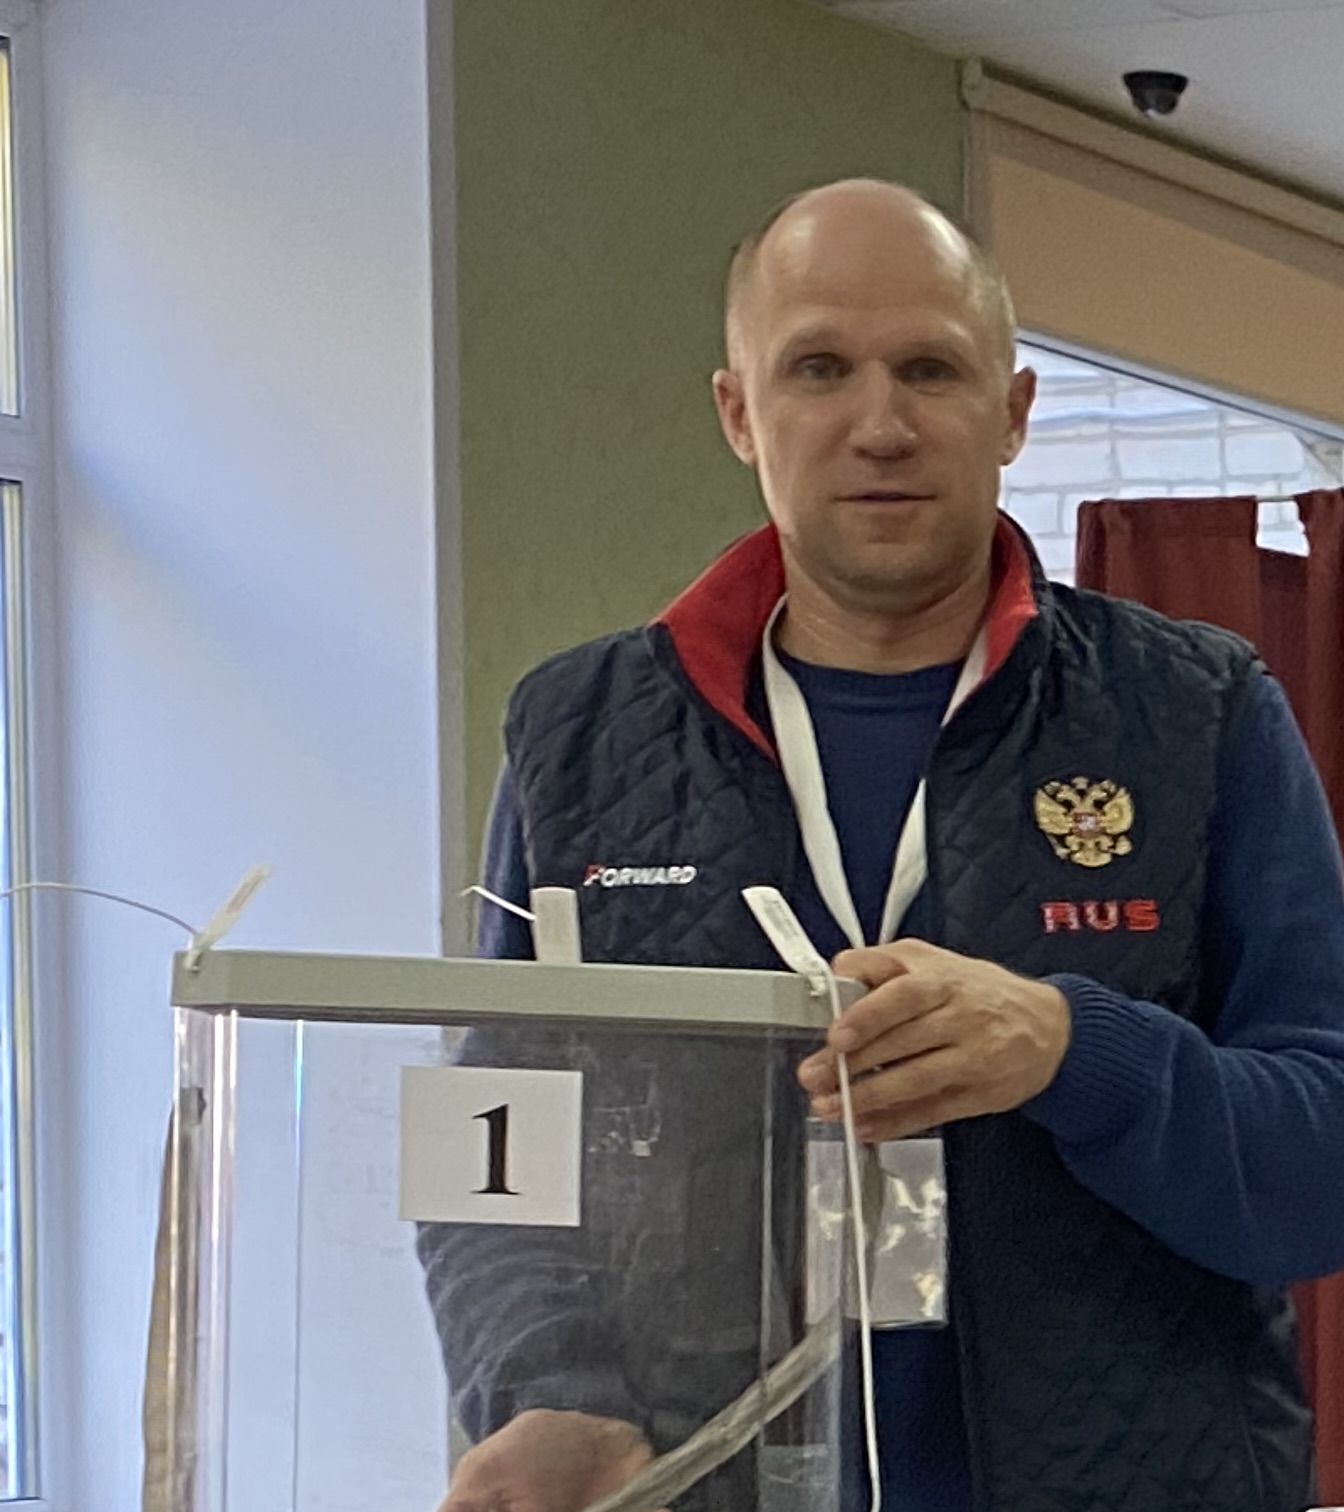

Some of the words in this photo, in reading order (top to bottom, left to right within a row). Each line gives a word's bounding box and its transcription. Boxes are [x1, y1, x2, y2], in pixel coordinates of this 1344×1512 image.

[582, 863, 698, 887] FORWARD
[1040, 898, 1160, 934] RUS
[471, 1102, 521, 1197] 1
